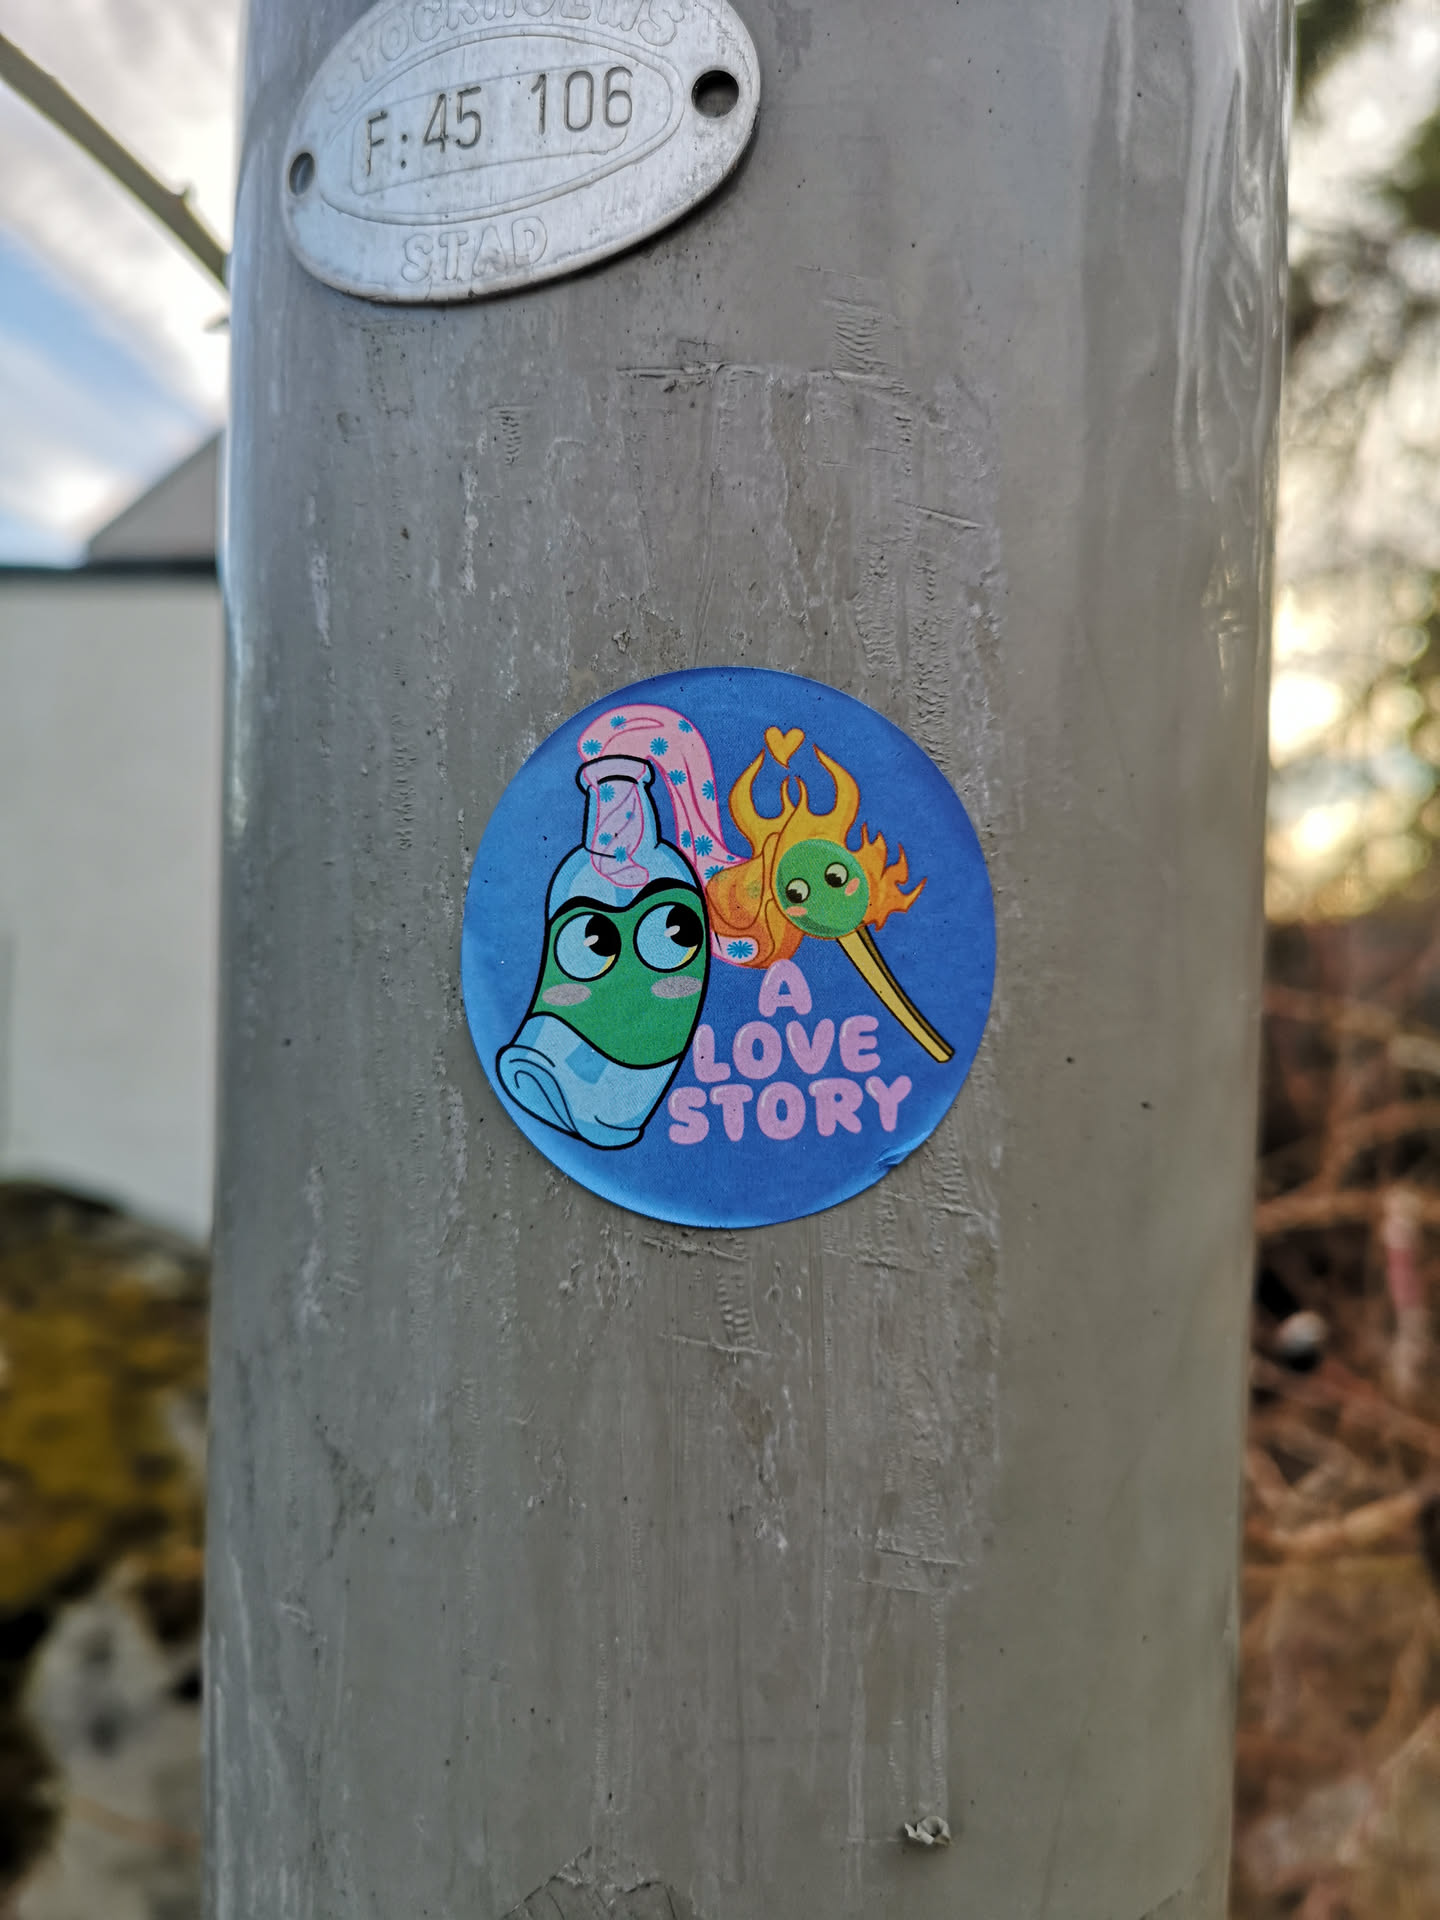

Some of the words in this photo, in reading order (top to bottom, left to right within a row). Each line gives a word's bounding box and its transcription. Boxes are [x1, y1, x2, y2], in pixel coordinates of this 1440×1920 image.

[530, 66, 633, 135] 106
[400, 216, 549, 283] STAD
[758, 959, 813, 1018] A
[692, 1015, 882, 1083] LOVE
[667, 1075, 913, 1145] STORY
